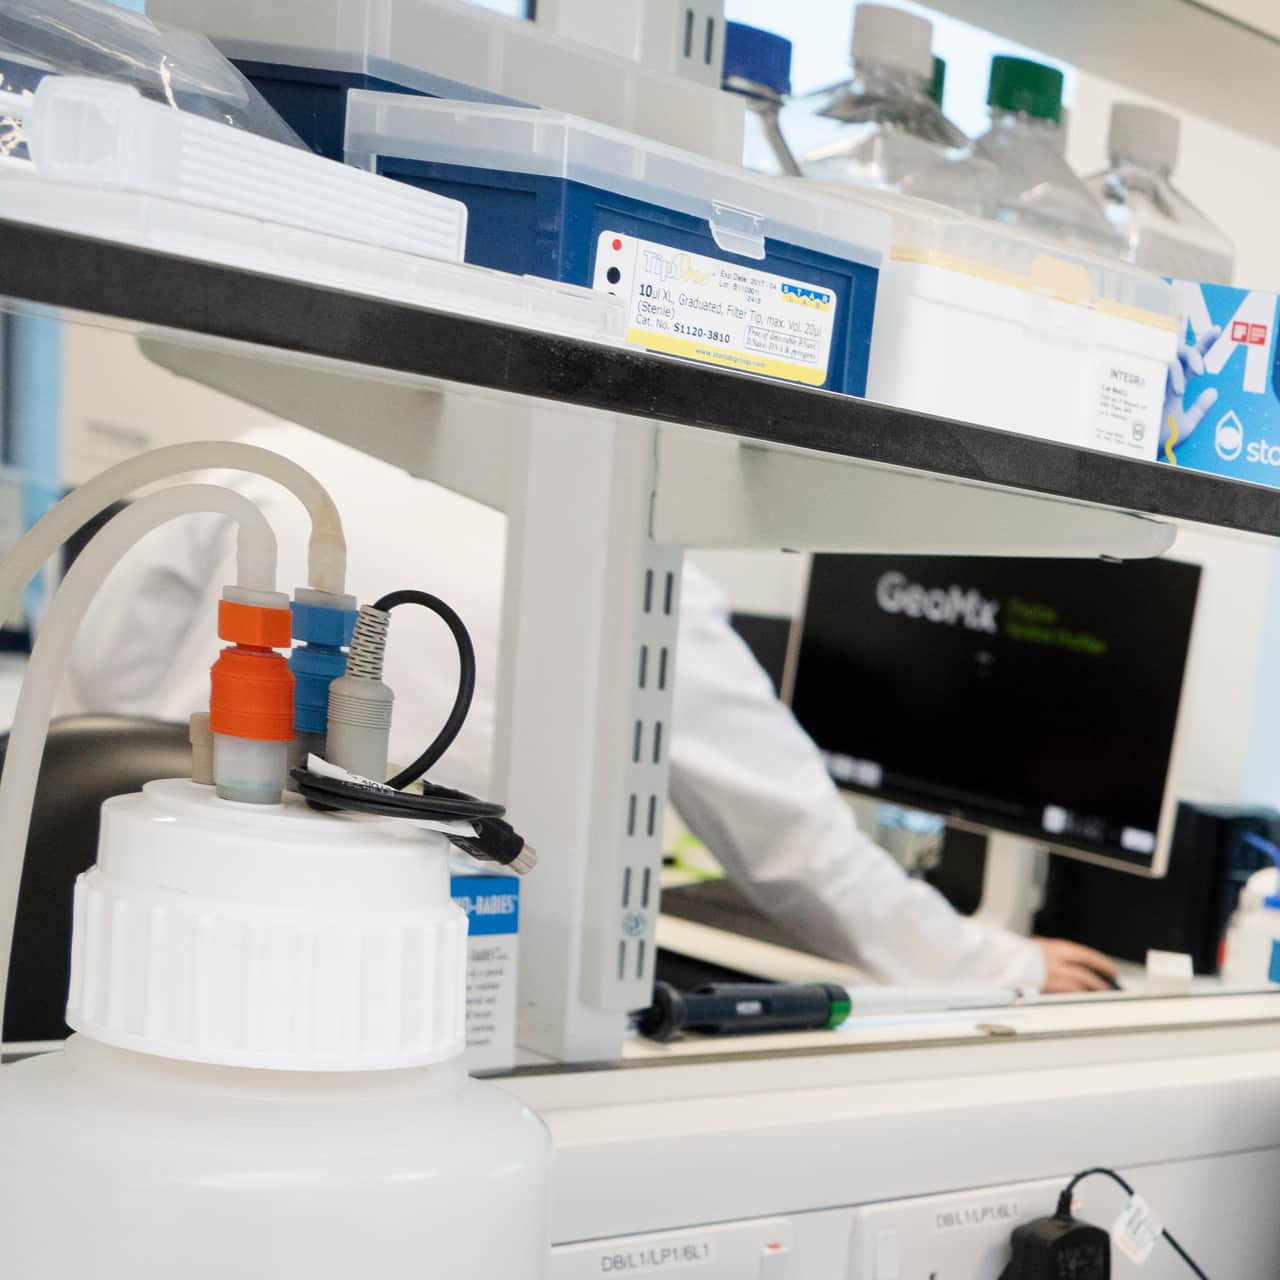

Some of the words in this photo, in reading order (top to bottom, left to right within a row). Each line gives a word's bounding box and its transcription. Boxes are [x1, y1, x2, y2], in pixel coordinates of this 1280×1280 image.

[637, 300, 675, 320] (Sterile)
[726, 303, 747, 319] Filter
[636, 313, 653, 327] Cat.
[674, 322, 731, 344] S1120-3810
